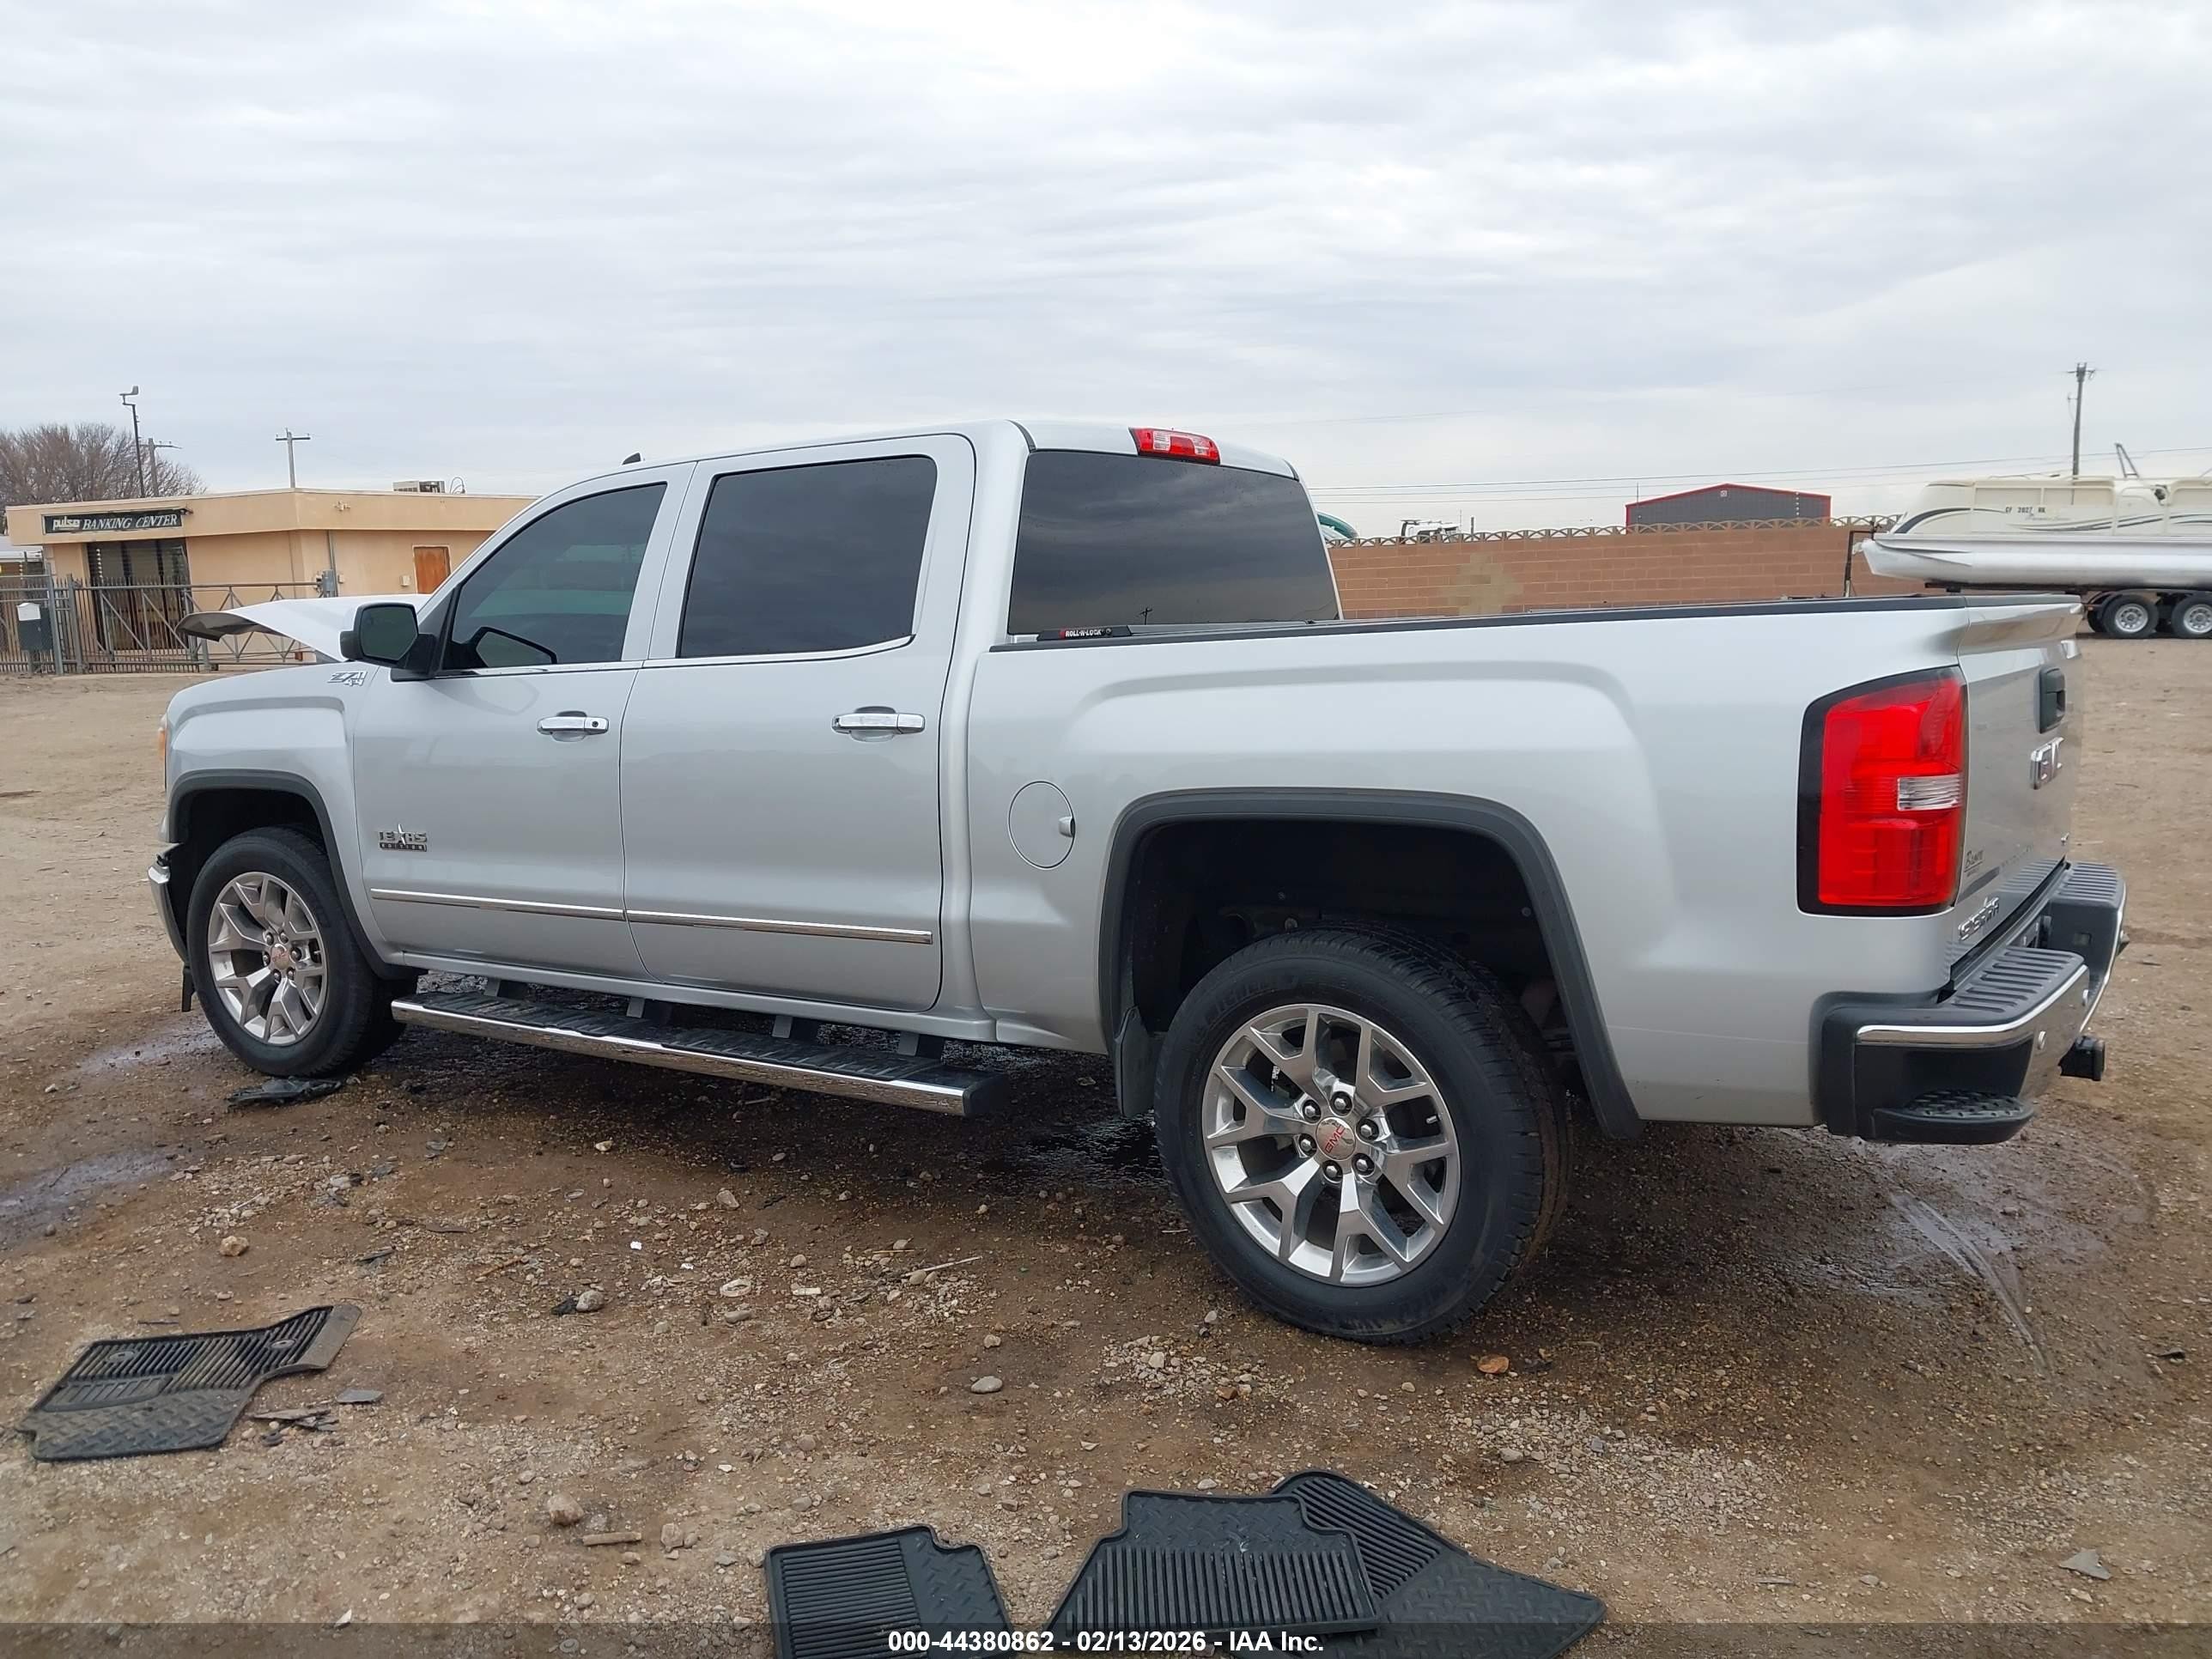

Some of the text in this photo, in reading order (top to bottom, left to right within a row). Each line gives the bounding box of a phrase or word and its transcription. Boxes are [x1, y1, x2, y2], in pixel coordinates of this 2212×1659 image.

[52, 514, 178, 531] pulse BANKING CENTER
[1324, 1124, 1346, 1154] GMC
